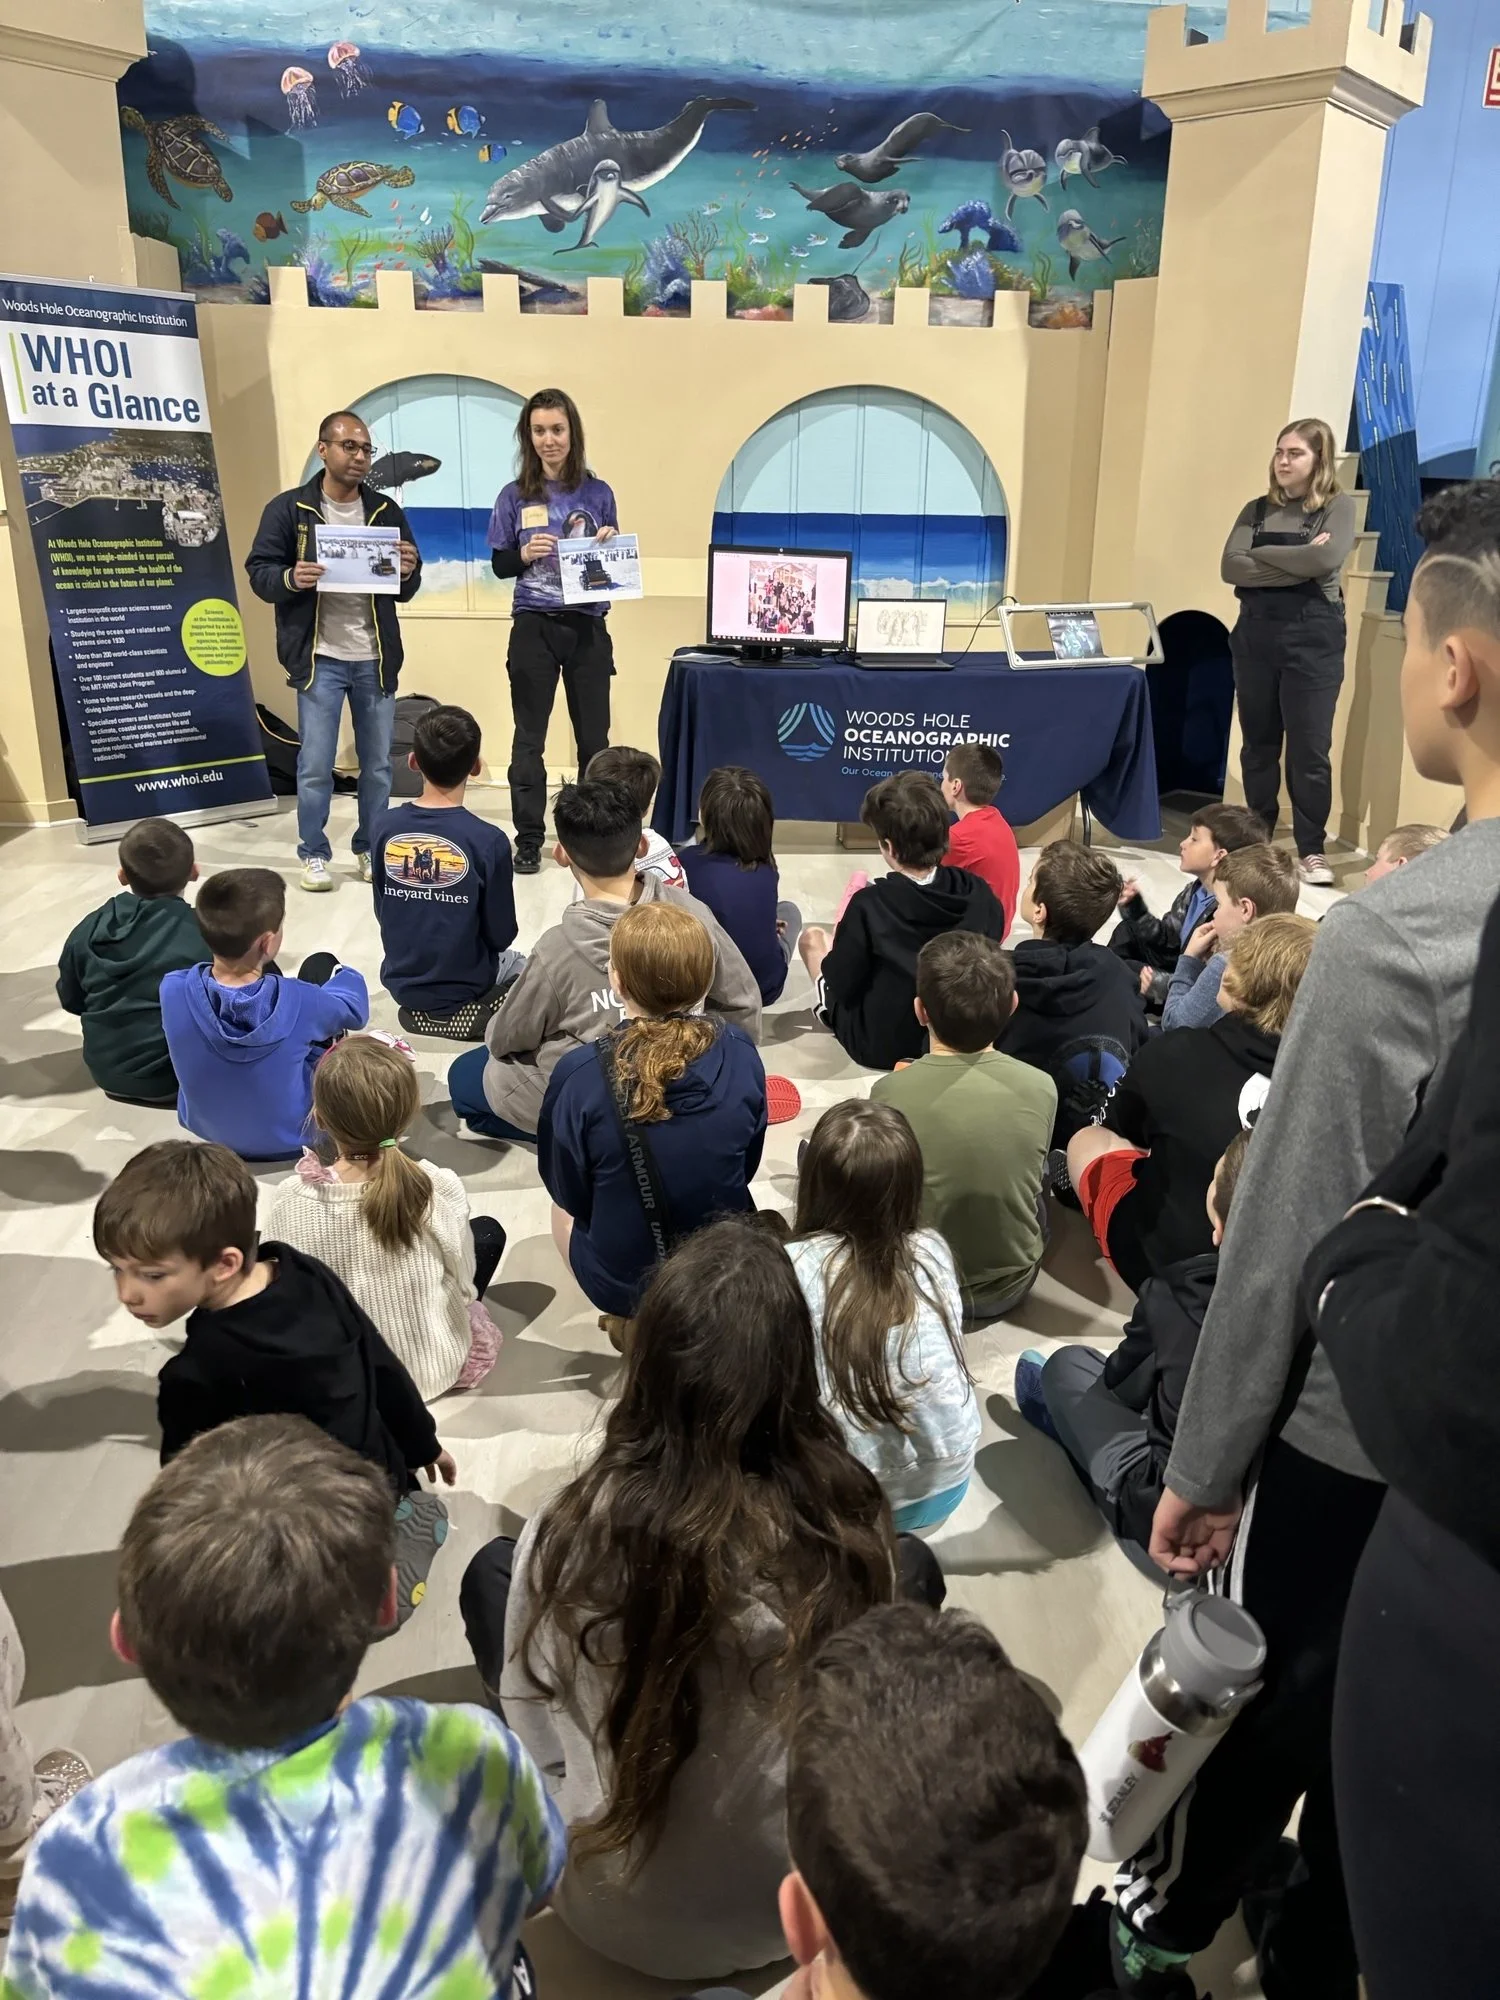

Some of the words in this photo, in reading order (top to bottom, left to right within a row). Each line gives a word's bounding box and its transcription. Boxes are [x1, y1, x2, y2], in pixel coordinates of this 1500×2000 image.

[3, 299, 38, 314] Woods
[40, 302, 64, 317] Hole
[65, 304, 138, 323] Oceanographic
[138, 312, 188, 328] Institution
[20, 332, 132, 379] WHOI
[32, 381, 58, 406] at
[62, 386, 78, 407] a
[88, 382, 200, 424] Glance
[56, 539, 77, 549] Woods
[78, 539, 91, 548] Hole
[92, 538, 135, 549] Oceanographic
[173, 564, 182, 573] the
[55, 582, 74, 590] ocean
[109, 579, 119, 588] the
[66, 607, 87, 616] Largest
[87, 606, 111, 616] nonprofit
[70, 630, 95, 638] Studying
[136, 626, 156, 634] related
[72, 639, 95, 647] systems
[88, 661, 114, 669] engineers
[132, 680, 155, 688] Program
[120, 693, 143, 701] research
[85, 706, 101, 714] diving
[87, 718, 117, 727] Specialized
[172, 710, 191, 718] focused
[845, 710, 915, 727] WOODS
[923, 713, 971, 729] HOLE
[118, 724, 137, 732] coastal
[157, 729, 174, 737] marine
[145, 739, 162, 747] marine
[844, 728, 1011, 748] OCEANOGRAPHIC
[843, 745, 950, 764] INSTITUTIO
[841, 766, 859, 776] Our
[135, 770, 224, 792] www.whoi.edu
[384, 884, 432, 902] ineyard
[434, 890, 469, 904] vines
[626, 1133, 656, 1209] ARMOUR
